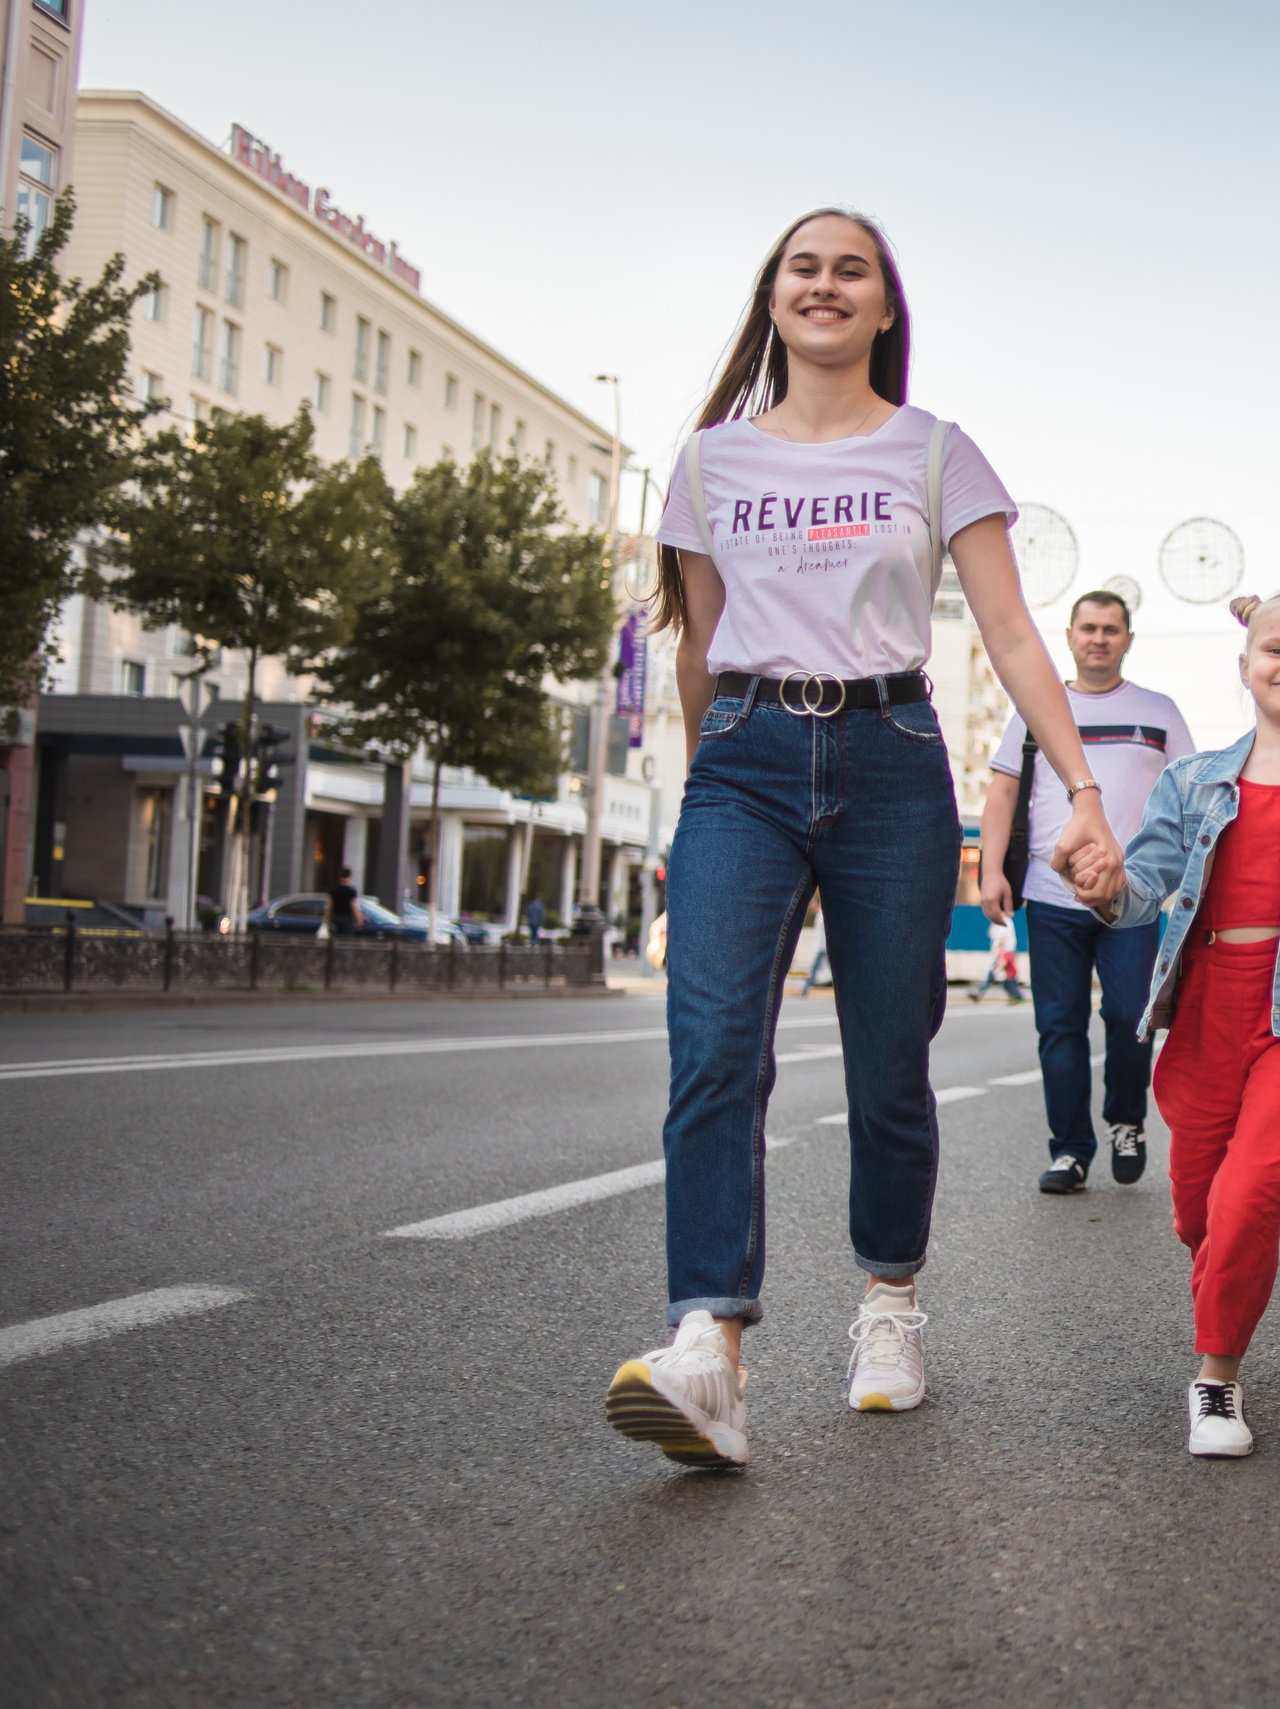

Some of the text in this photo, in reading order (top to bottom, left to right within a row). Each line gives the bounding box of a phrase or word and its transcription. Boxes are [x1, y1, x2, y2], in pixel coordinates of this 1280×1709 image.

[725, 535, 750, 550] STATE
[755, 533, 767, 544] OF
[772, 530, 804, 543] BEING
[808, 525, 870, 541] PLEASANTLY
[875, 524, 899, 534] LOST
[903, 524, 912, 534] IN
[768, 539, 857, 557] ONE'S THOUGHTS:
